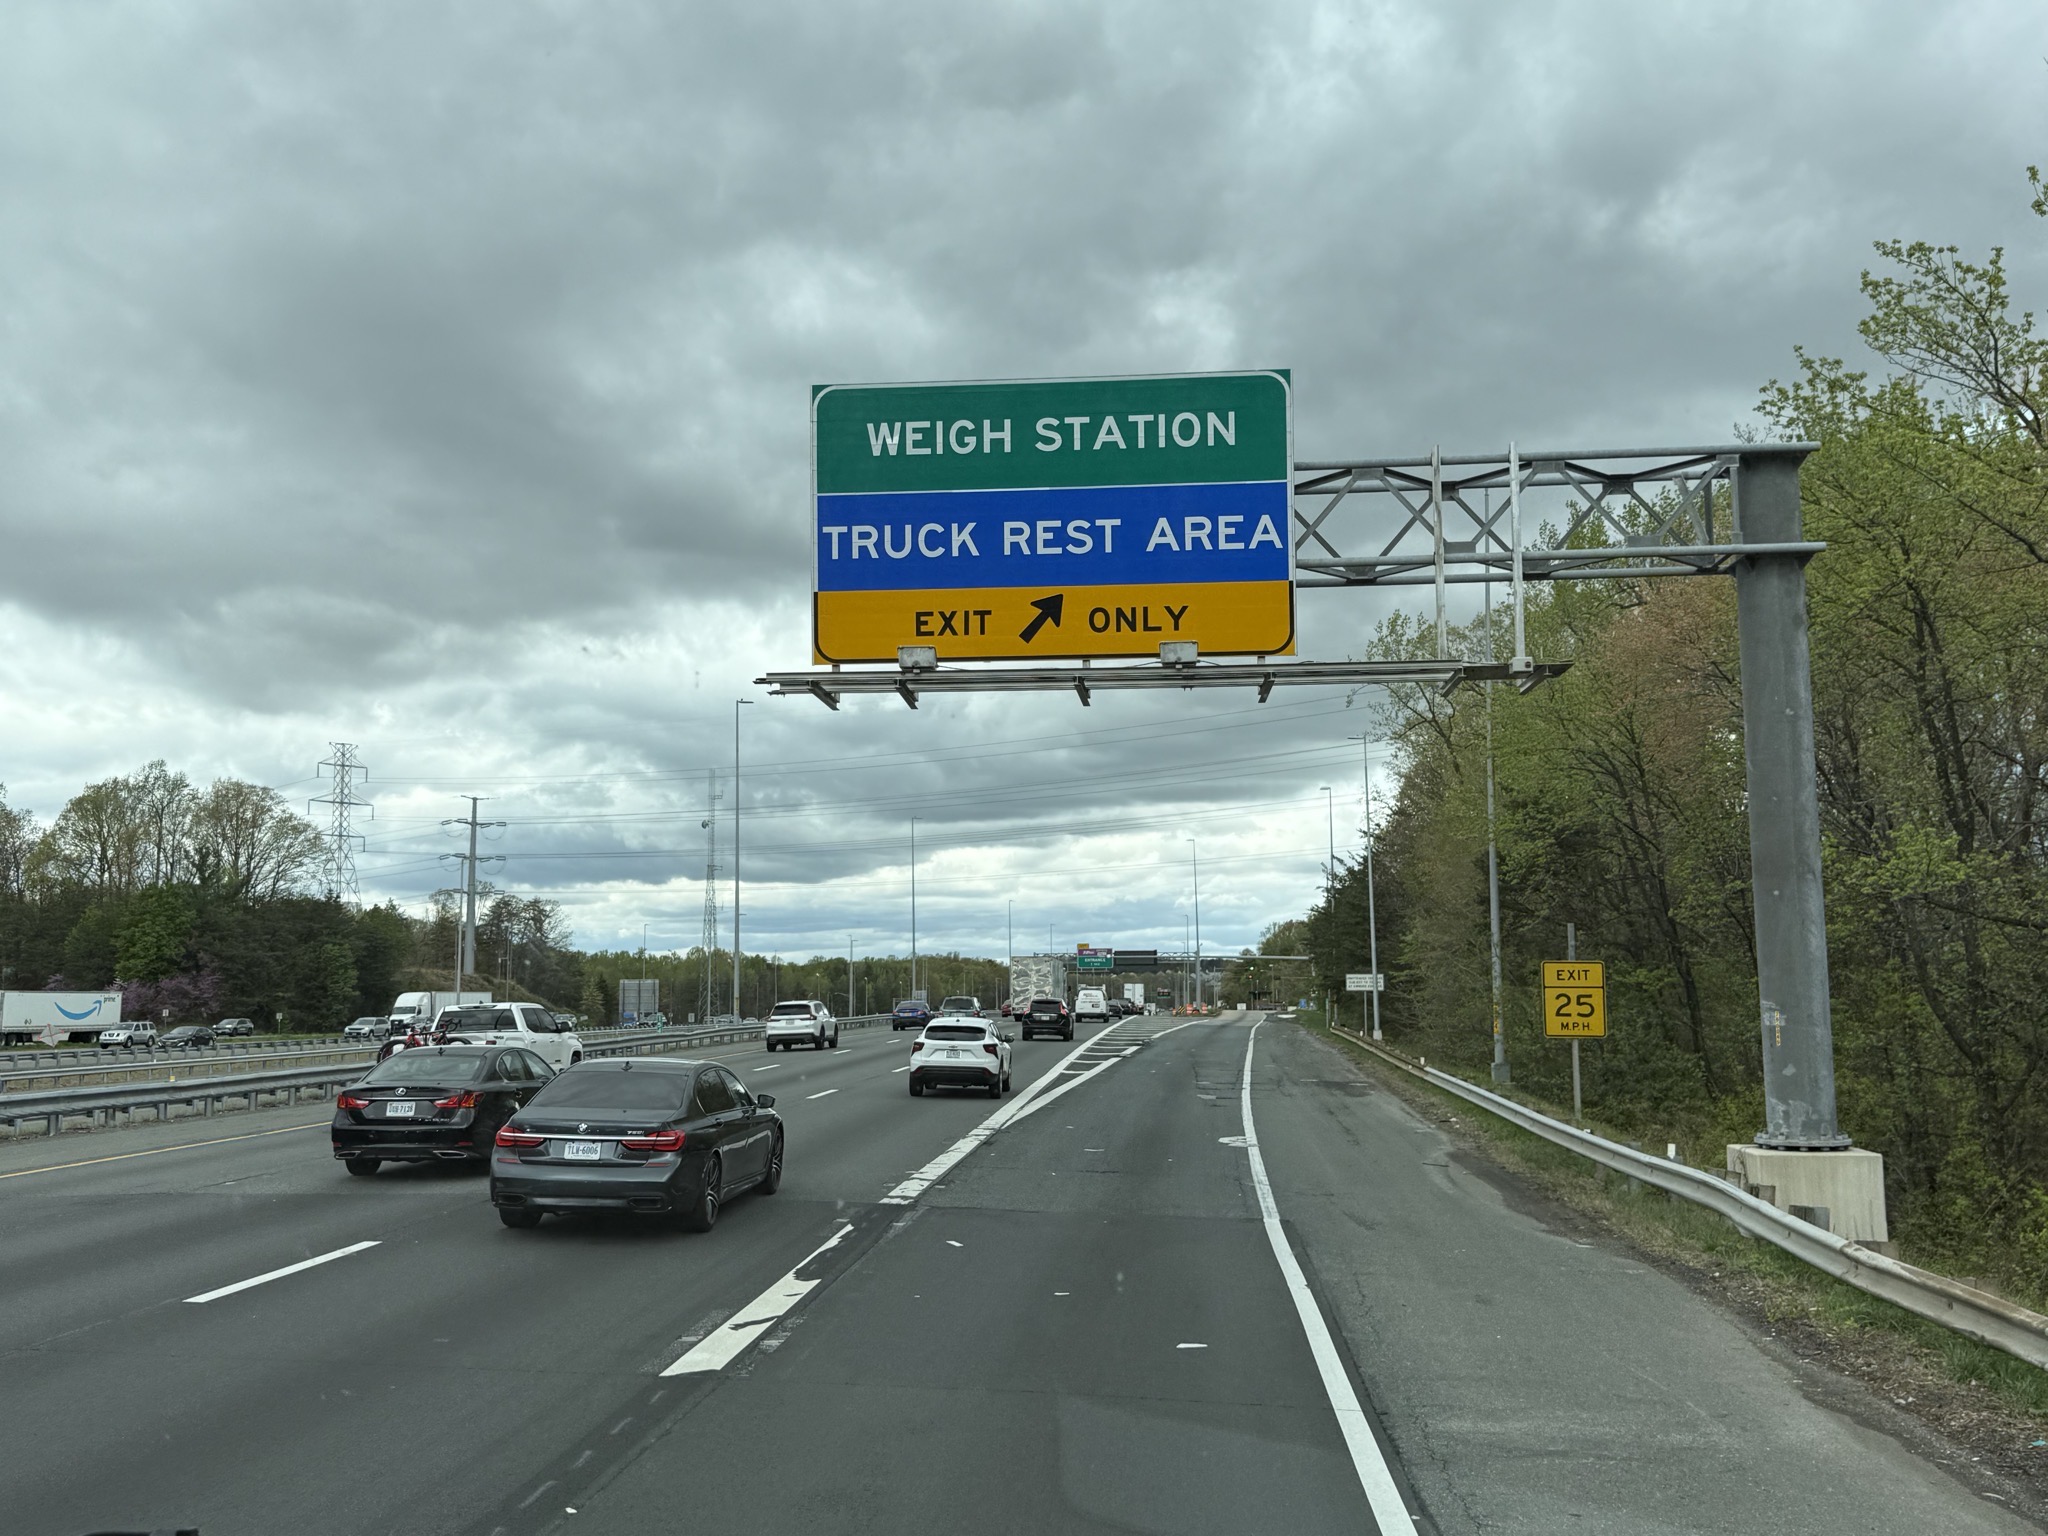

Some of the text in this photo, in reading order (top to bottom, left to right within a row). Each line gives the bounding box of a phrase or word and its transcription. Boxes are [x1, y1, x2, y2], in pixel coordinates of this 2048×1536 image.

[866, 410, 1236, 457] WEIGH STATION
[822, 514, 1283, 560] TRUCK REST AREA
[915, 605, 1189, 637] EXIT ONLY
[1556, 969, 1591, 981] EXIT
[1555, 992, 1595, 1018] 25
